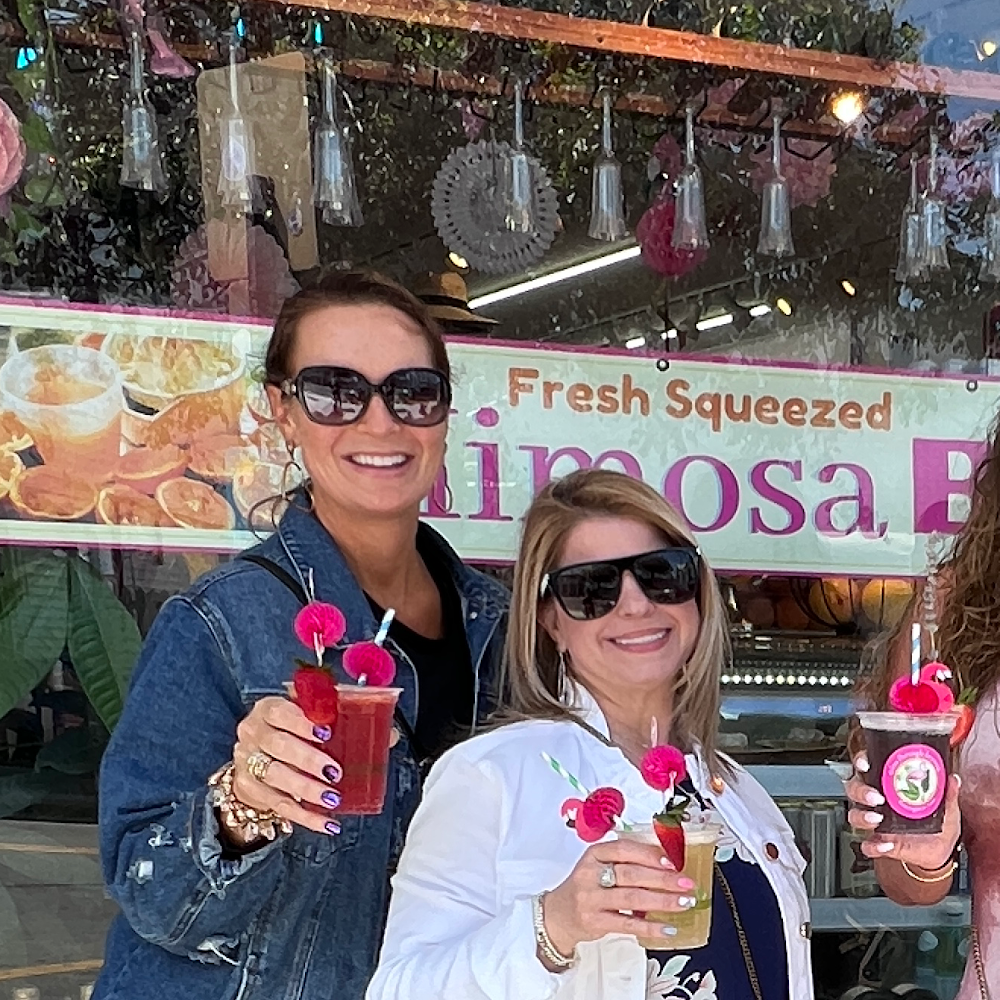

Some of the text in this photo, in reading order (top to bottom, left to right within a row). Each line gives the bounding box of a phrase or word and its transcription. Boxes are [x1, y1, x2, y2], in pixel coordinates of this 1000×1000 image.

[508, 366, 893, 433] Fresh Squeezed
[419, 406, 889, 539] imosa
